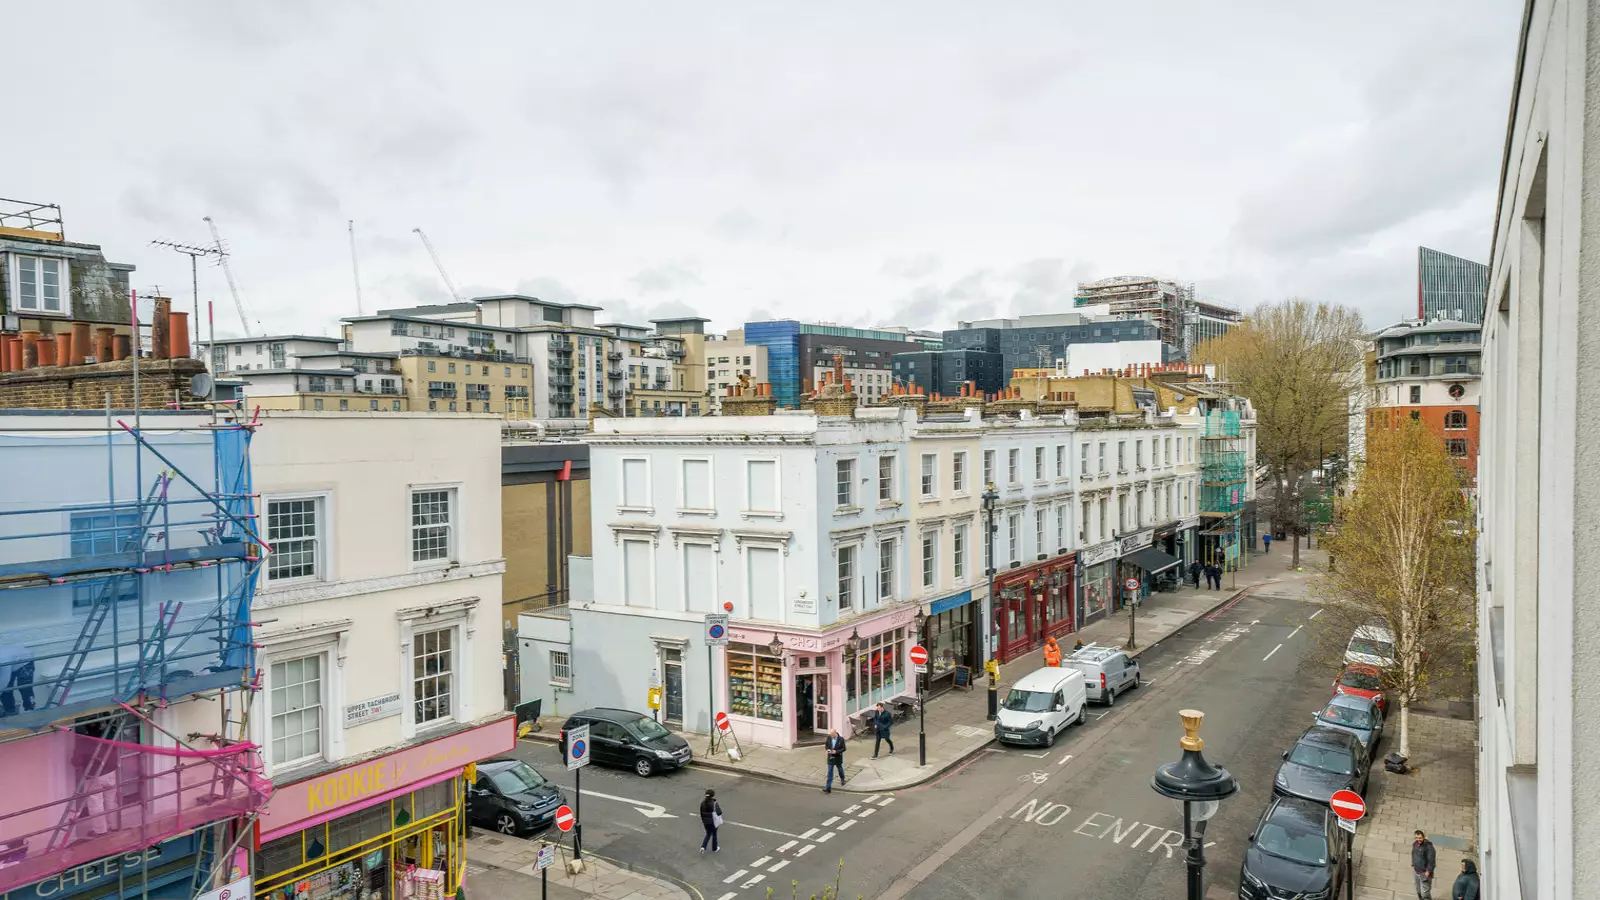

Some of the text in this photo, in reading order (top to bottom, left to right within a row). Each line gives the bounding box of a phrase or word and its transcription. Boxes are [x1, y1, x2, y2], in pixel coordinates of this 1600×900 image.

[347, 694, 400, 714] UPPER TACHBROOK
[347, 709, 369, 720] STREET
[572, 732, 586, 741] ZONE
[308, 762, 387, 812] KOOKIE
[1010, 798, 1216, 858] NO ENTR
[36, 848, 160, 896] CHEESE
